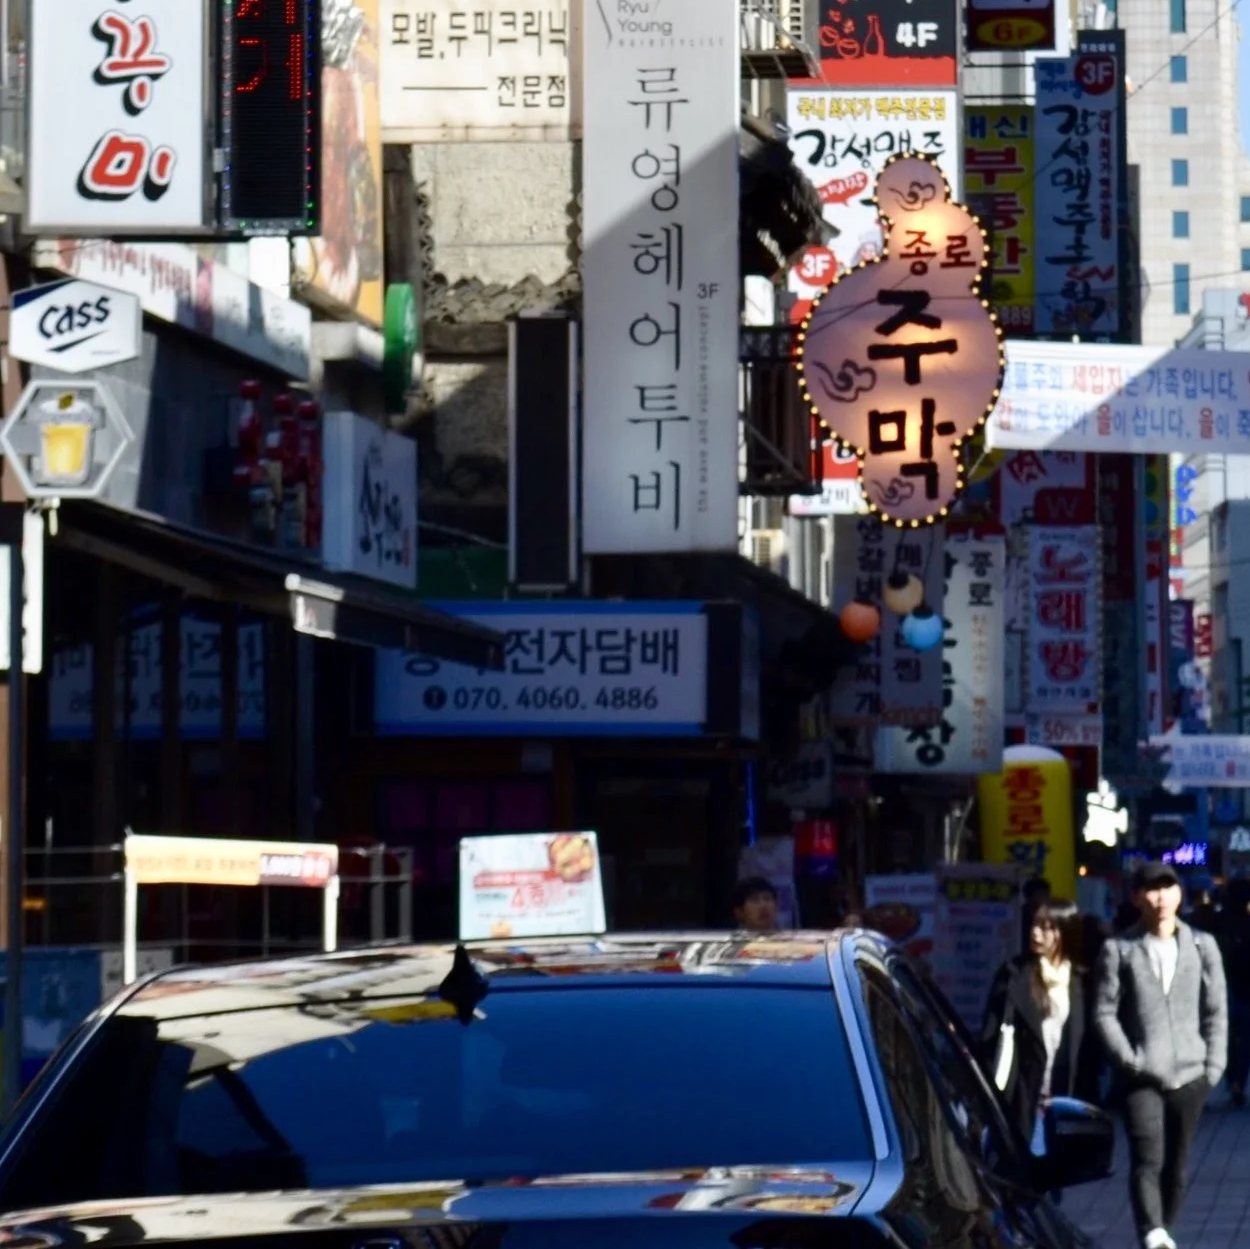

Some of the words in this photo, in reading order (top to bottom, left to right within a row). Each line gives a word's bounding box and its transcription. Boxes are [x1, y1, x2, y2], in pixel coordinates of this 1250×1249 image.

[617, 0, 650, 15] Ryu
[617, 18, 672, 36] Young
[895, 23, 939, 48] 4F
[1081, 59, 1114, 84] 3F
[497, 75, 566, 108] 전문점
[801, 257, 832, 276] 3F
[900, 231, 977, 276] 종로
[626, 67, 690, 532] 류영헤어투비
[697, 283, 719, 299] 3F
[867, 290, 958, 499] 주막
[1073, 365, 1139, 394] 세입자는
[1146, 368, 1237, 400] 가족입니다.
[1097, 403, 1128, 437] 을이
[1132, 408, 1191, 438] 삽니다.
[1198, 406, 1229, 439] 을이
[1035, 546, 1093, 683] 노래방
[404, 628, 680, 676] 전자담배
[595, 687, 659, 710] 4886
